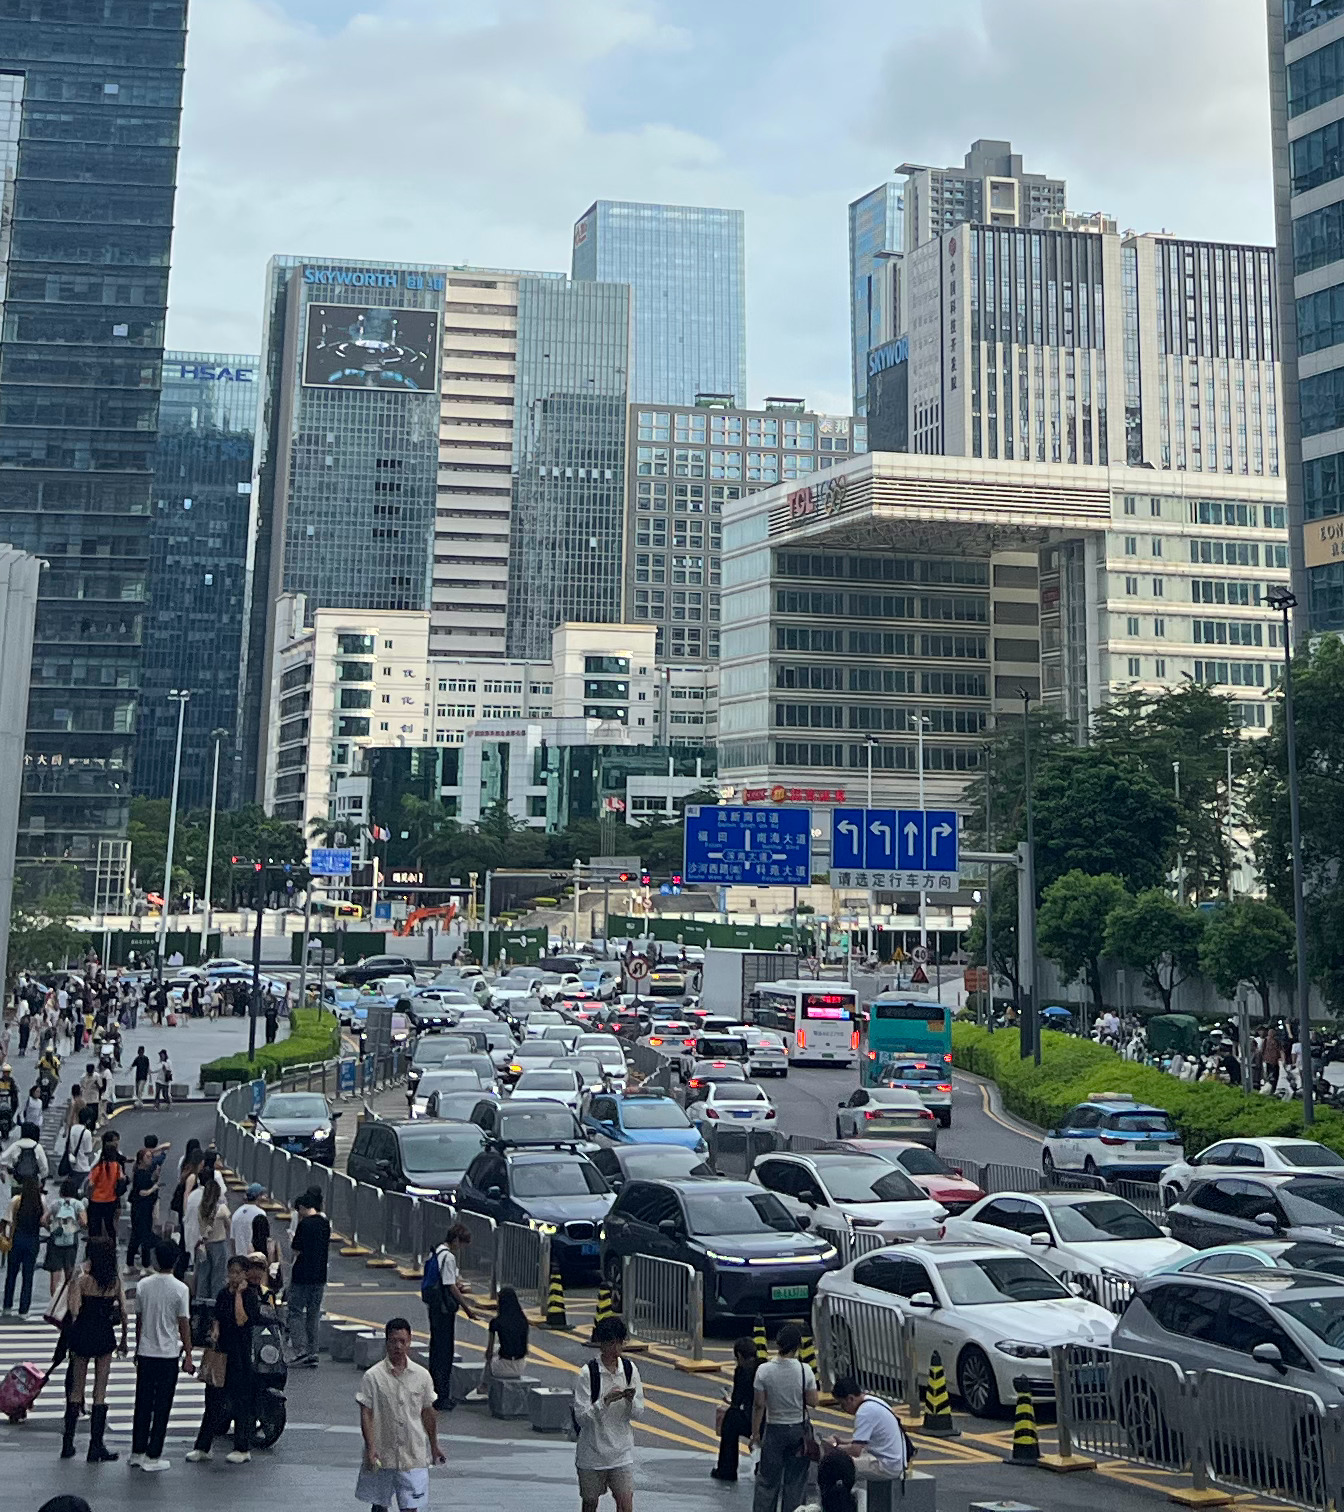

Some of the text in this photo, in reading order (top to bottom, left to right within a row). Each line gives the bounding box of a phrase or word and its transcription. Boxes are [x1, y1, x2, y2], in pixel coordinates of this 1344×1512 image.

[304, 269, 398, 289] SKYWORTH
[787, 486, 814, 518] TCL
[838, 871, 951, 889] 请选定行车方向
